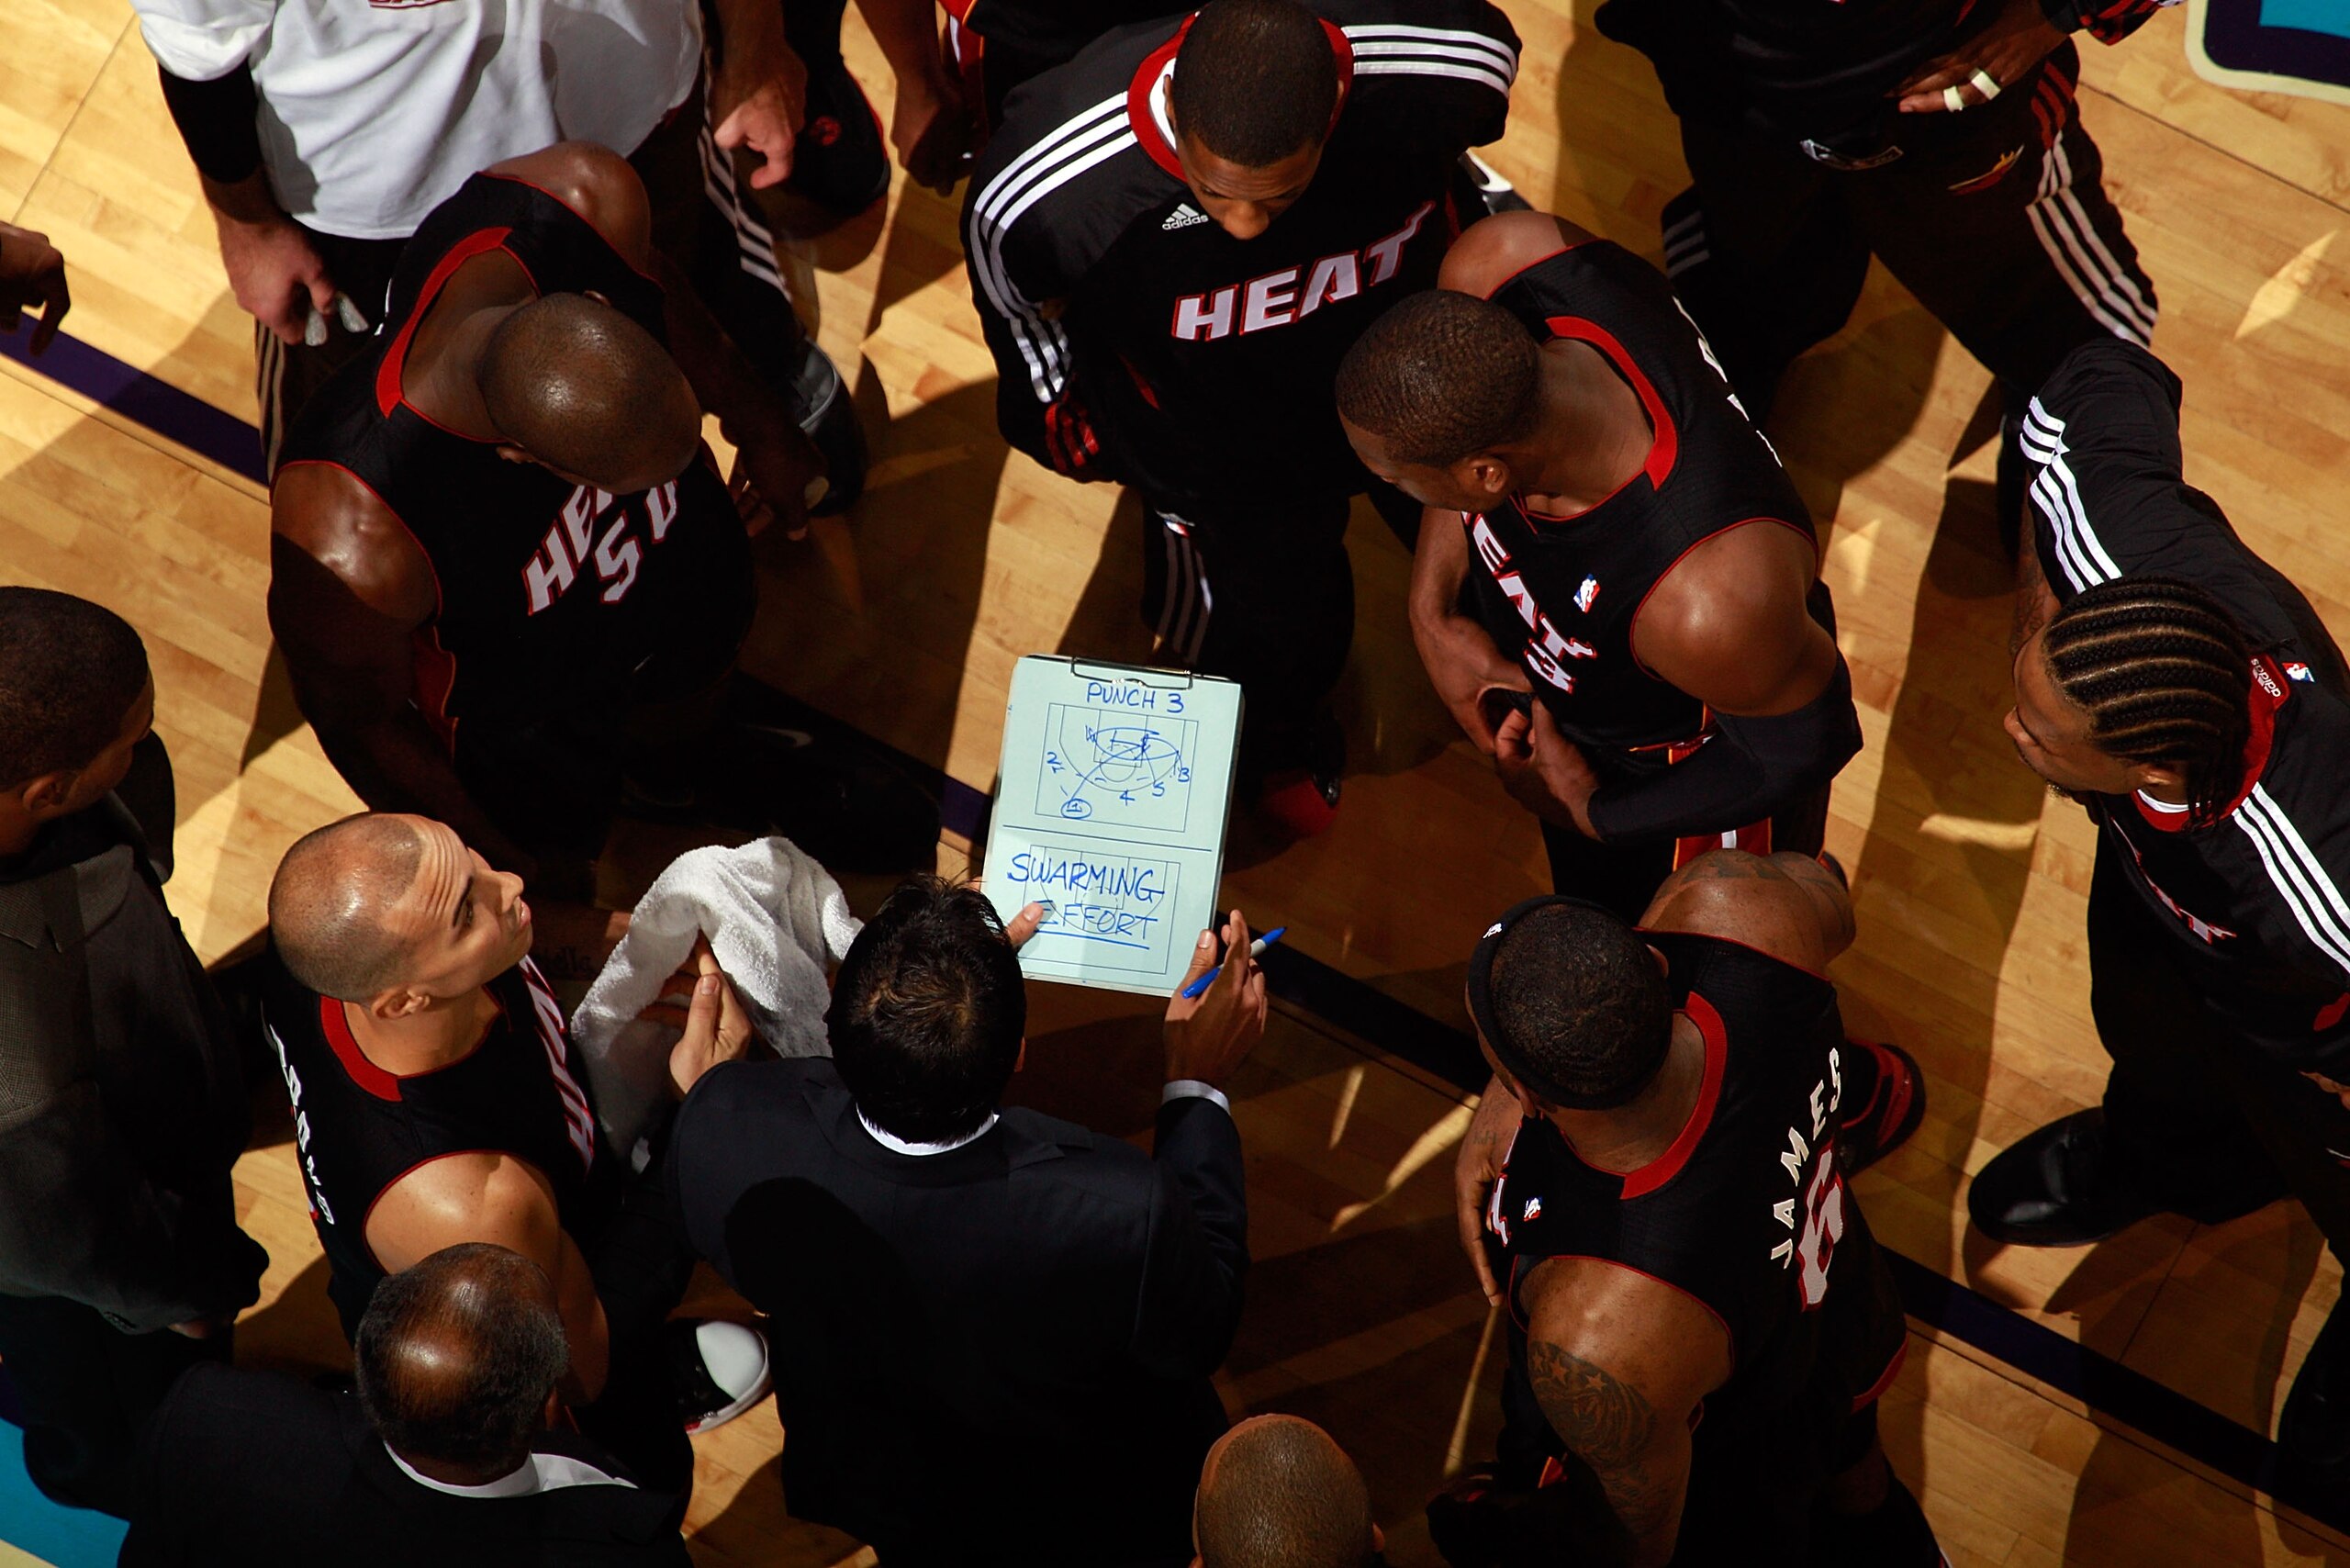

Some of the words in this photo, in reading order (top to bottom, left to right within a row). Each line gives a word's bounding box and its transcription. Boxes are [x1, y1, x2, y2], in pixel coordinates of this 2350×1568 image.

[1162, 214, 1209, 230] adidas
[1171, 200, 1437, 342] HEAT
[521, 485, 617, 616] HE
[1461, 510, 1597, 659] EAT
[1087, 682, 1156, 709] PUNCH
[1167, 693, 1184, 712] 3
[2251, 658, 2281, 697] adidas
[1119, 789, 1136, 806] 4
[1151, 781, 1166, 797] 5
[1007, 853, 1166, 903] SWARMING
[1770, 1047, 1841, 1270] JAMES
[1796, 1136, 1844, 1314] 6
